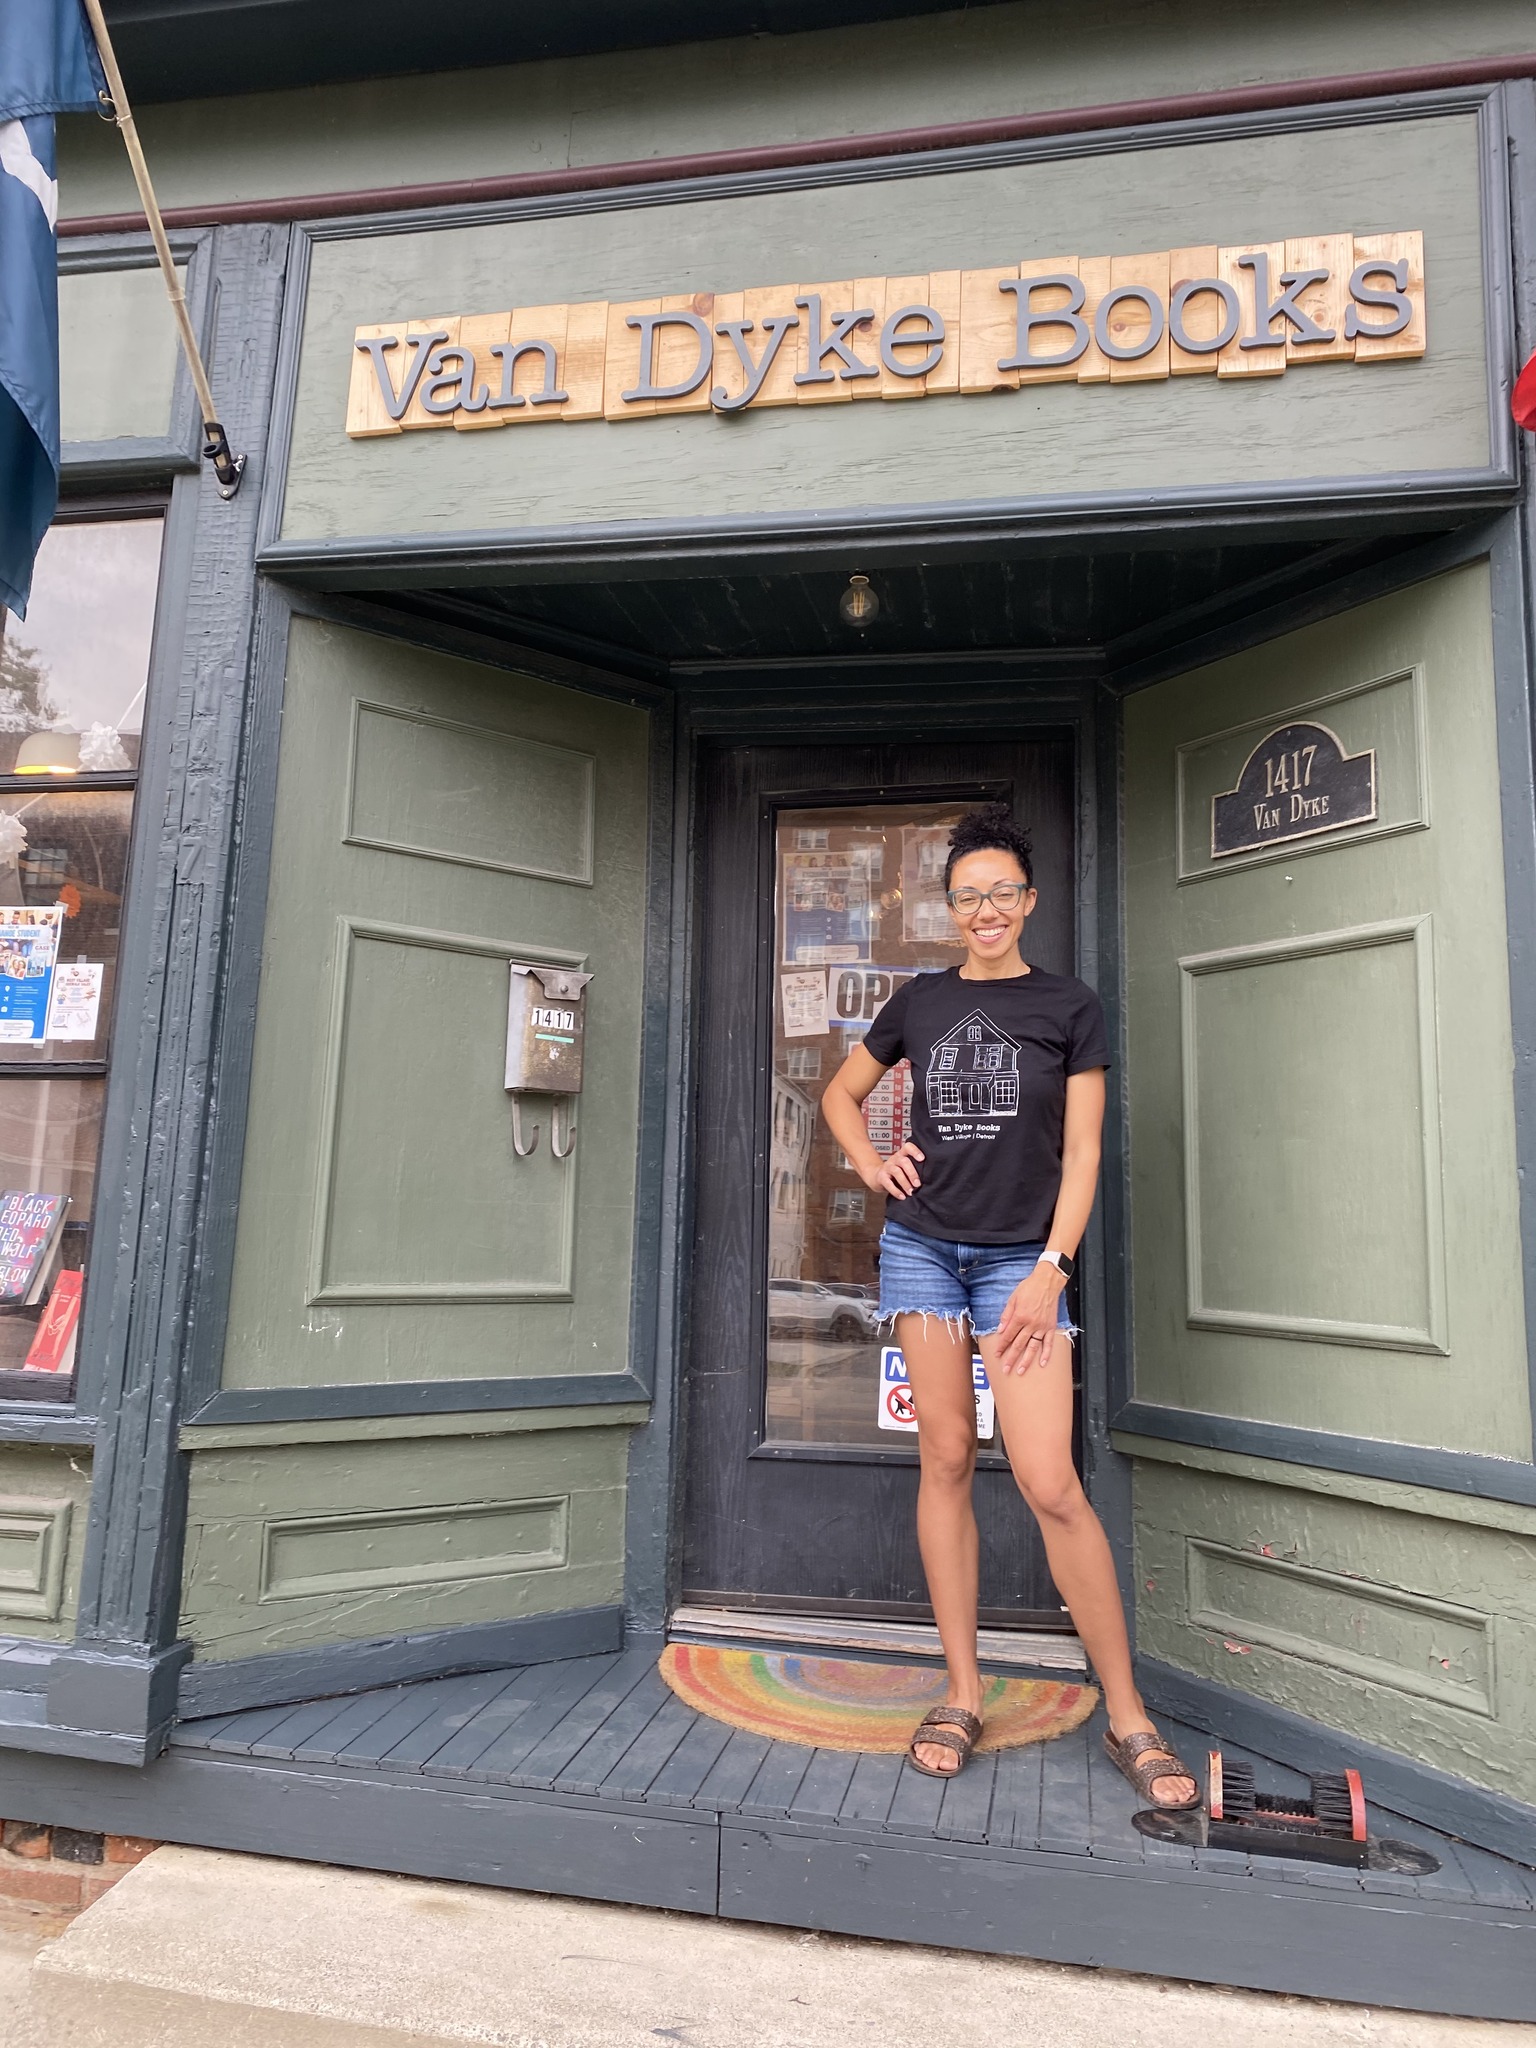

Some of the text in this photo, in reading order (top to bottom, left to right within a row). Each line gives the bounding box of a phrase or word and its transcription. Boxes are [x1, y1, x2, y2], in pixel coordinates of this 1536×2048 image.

[355, 252, 1413, 420] Van Dyke Books
[1264, 744, 1318, 798] 1417
[536, 1009, 572, 1029] 1417
[938, 1123, 1001, 1132] Van Dyke Books
[9, 1196, 53, 1214] BLACK
[1, 1210, 51, 1229] EOPARD
[1, 1241, 37, 1258] WOLF
